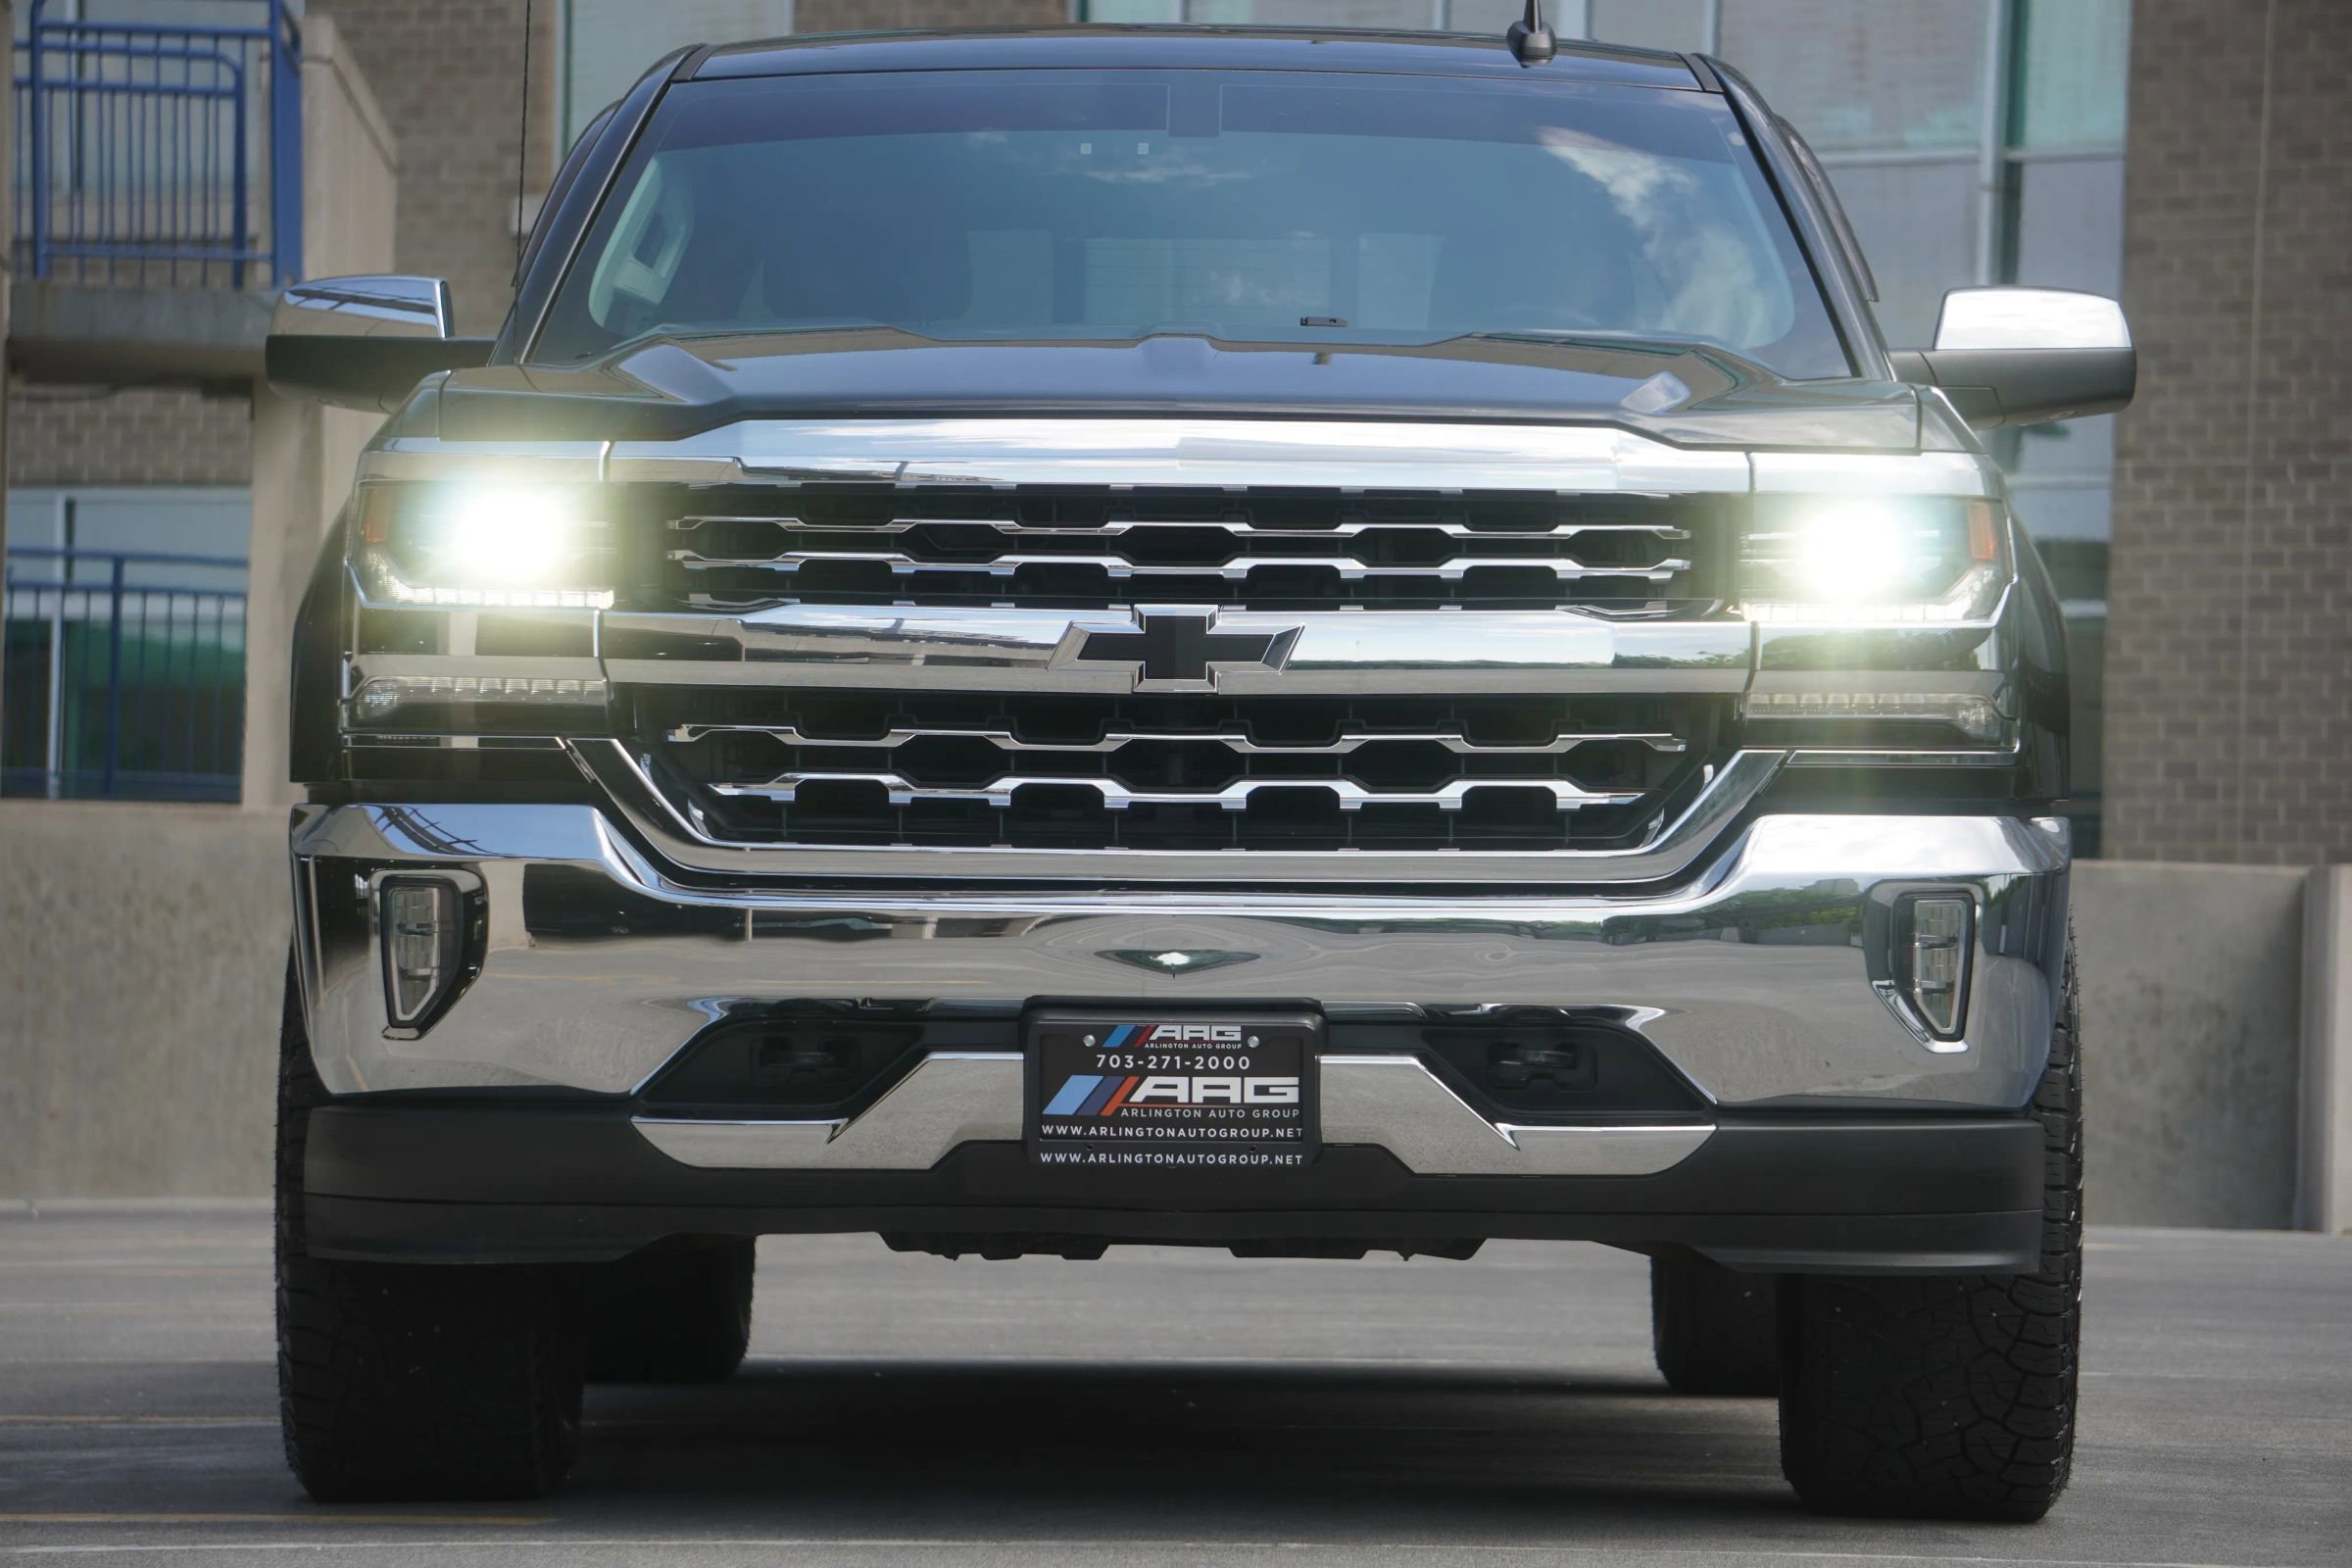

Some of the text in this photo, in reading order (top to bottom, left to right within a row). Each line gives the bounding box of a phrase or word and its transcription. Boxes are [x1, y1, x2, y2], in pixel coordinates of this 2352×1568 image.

[1096, 1054, 1250, 1070] 703-271-2000
[1128, 1076, 1299, 1103] AAG
[1120, 1107, 1299, 1118] ARLINGTON AUTO GROUP
[1042, 1125, 1303, 1139] WWW.ARLINGTONAUTOGROUP.NET
[1040, 1152, 1303, 1165] WWW.ARLINGTONAUTOGROUP.NET
